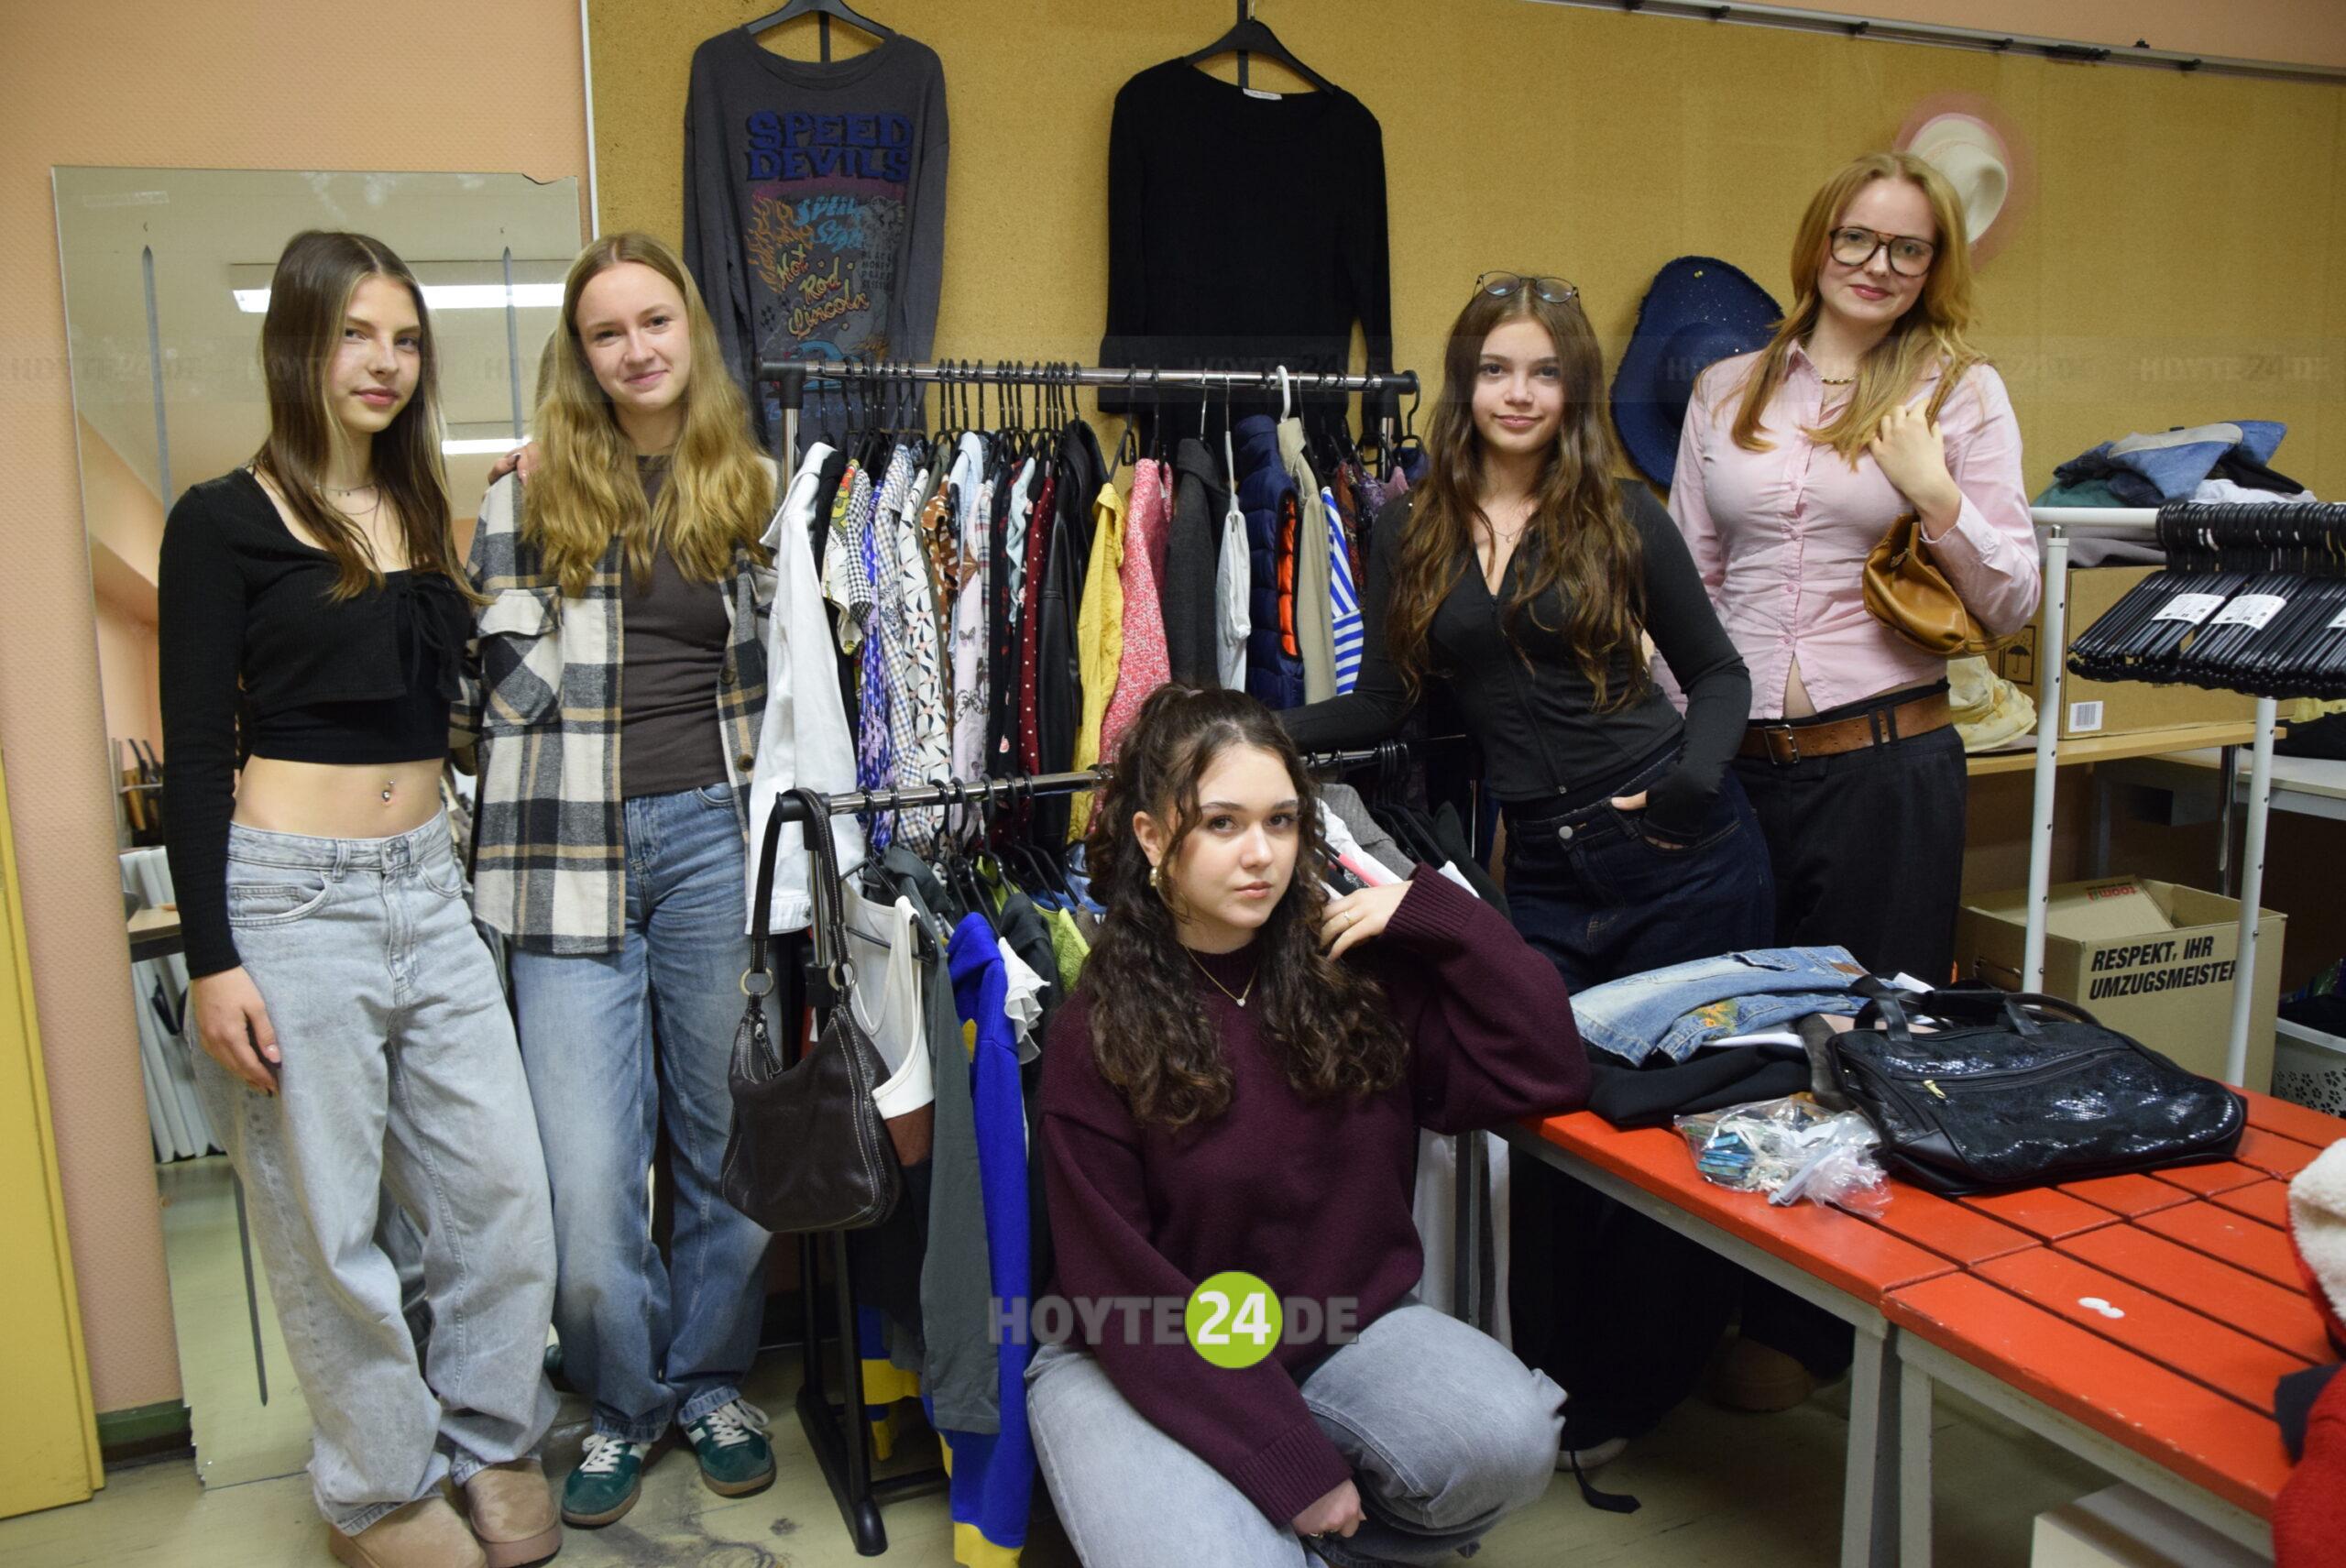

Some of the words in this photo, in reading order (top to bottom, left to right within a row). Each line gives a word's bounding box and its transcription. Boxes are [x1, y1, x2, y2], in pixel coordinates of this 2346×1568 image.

[746, 110, 915, 148] SPEED
[745, 147, 912, 182] DEVILS
[777, 243, 809, 291] Hot
[798, 256, 842, 305] Rod
[788, 278, 870, 341] Lincoln
[2090, 940, 2177, 972] RESPEKT,
[2183, 936, 2214, 960] IHR
